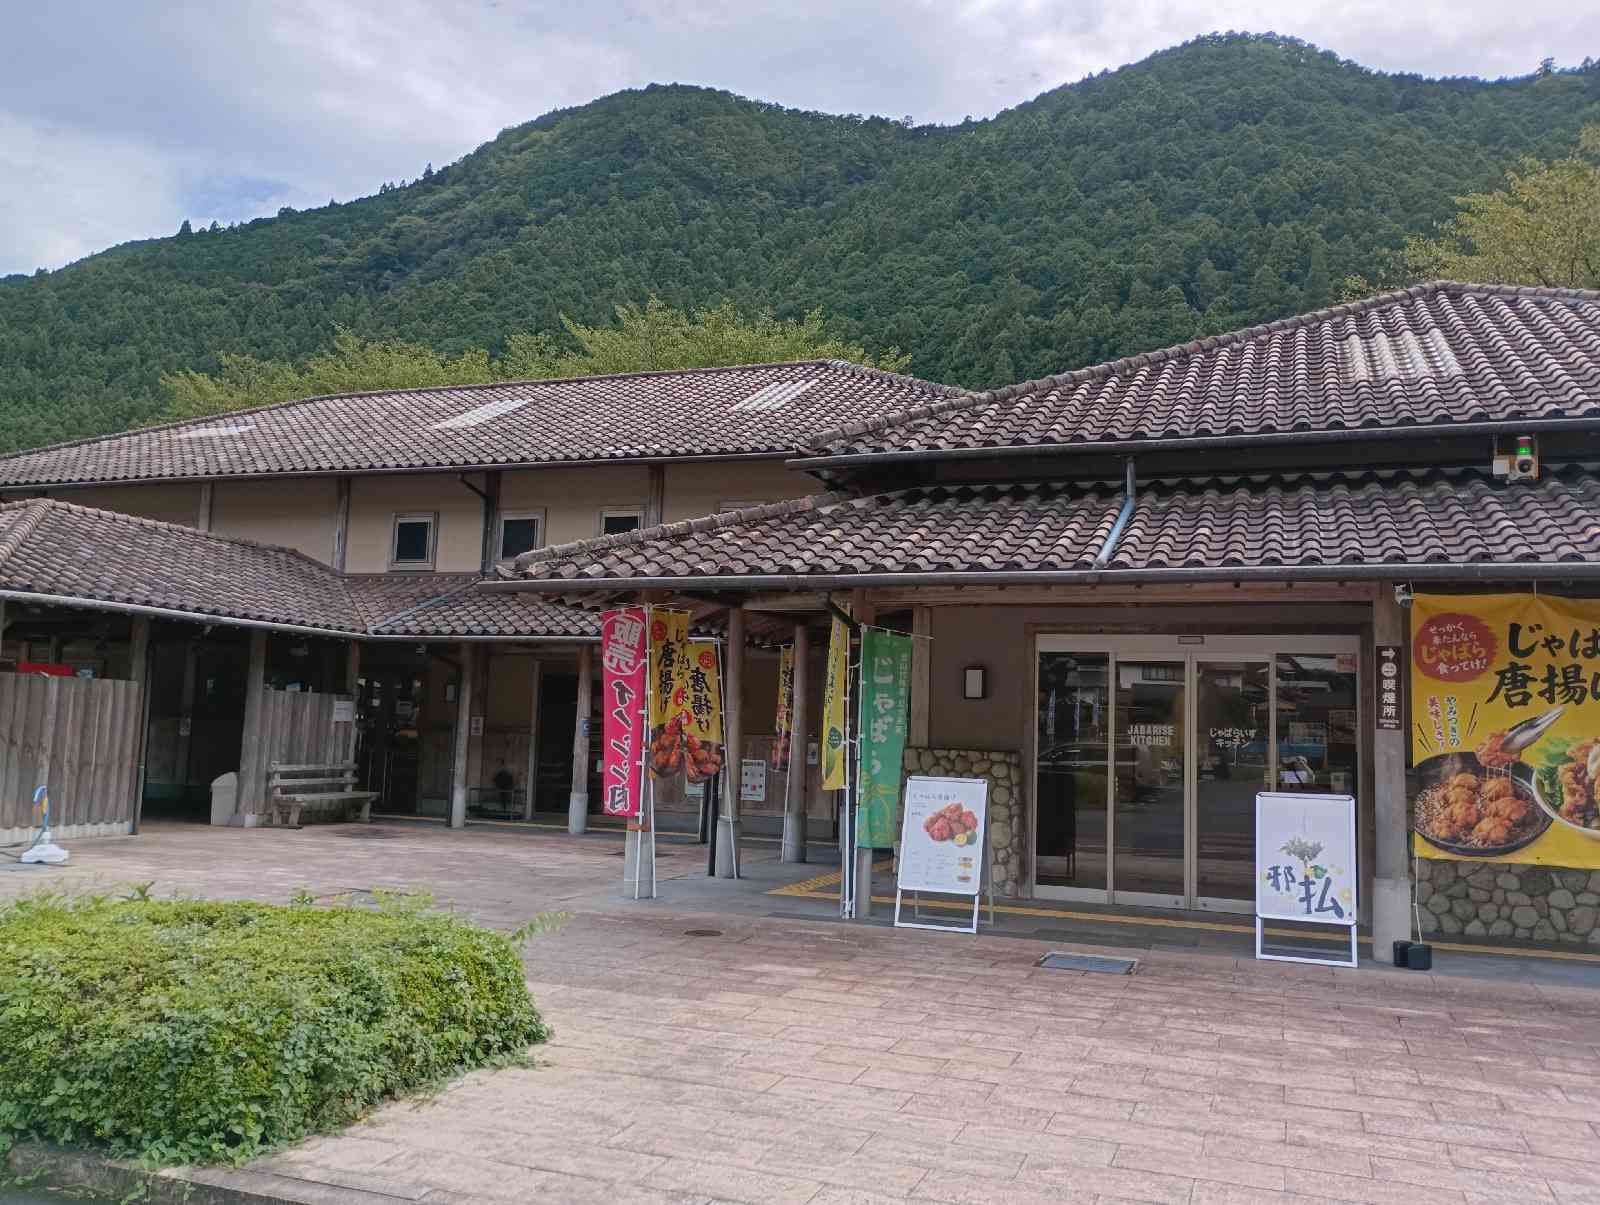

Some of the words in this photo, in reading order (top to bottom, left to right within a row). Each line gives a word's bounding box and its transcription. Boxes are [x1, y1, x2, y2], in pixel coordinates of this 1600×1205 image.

[1421, 641, 1487, 664] じゃばら
[657, 638, 677, 713] 唐揚げ
[1130, 735, 1170, 746] KITCHEN
